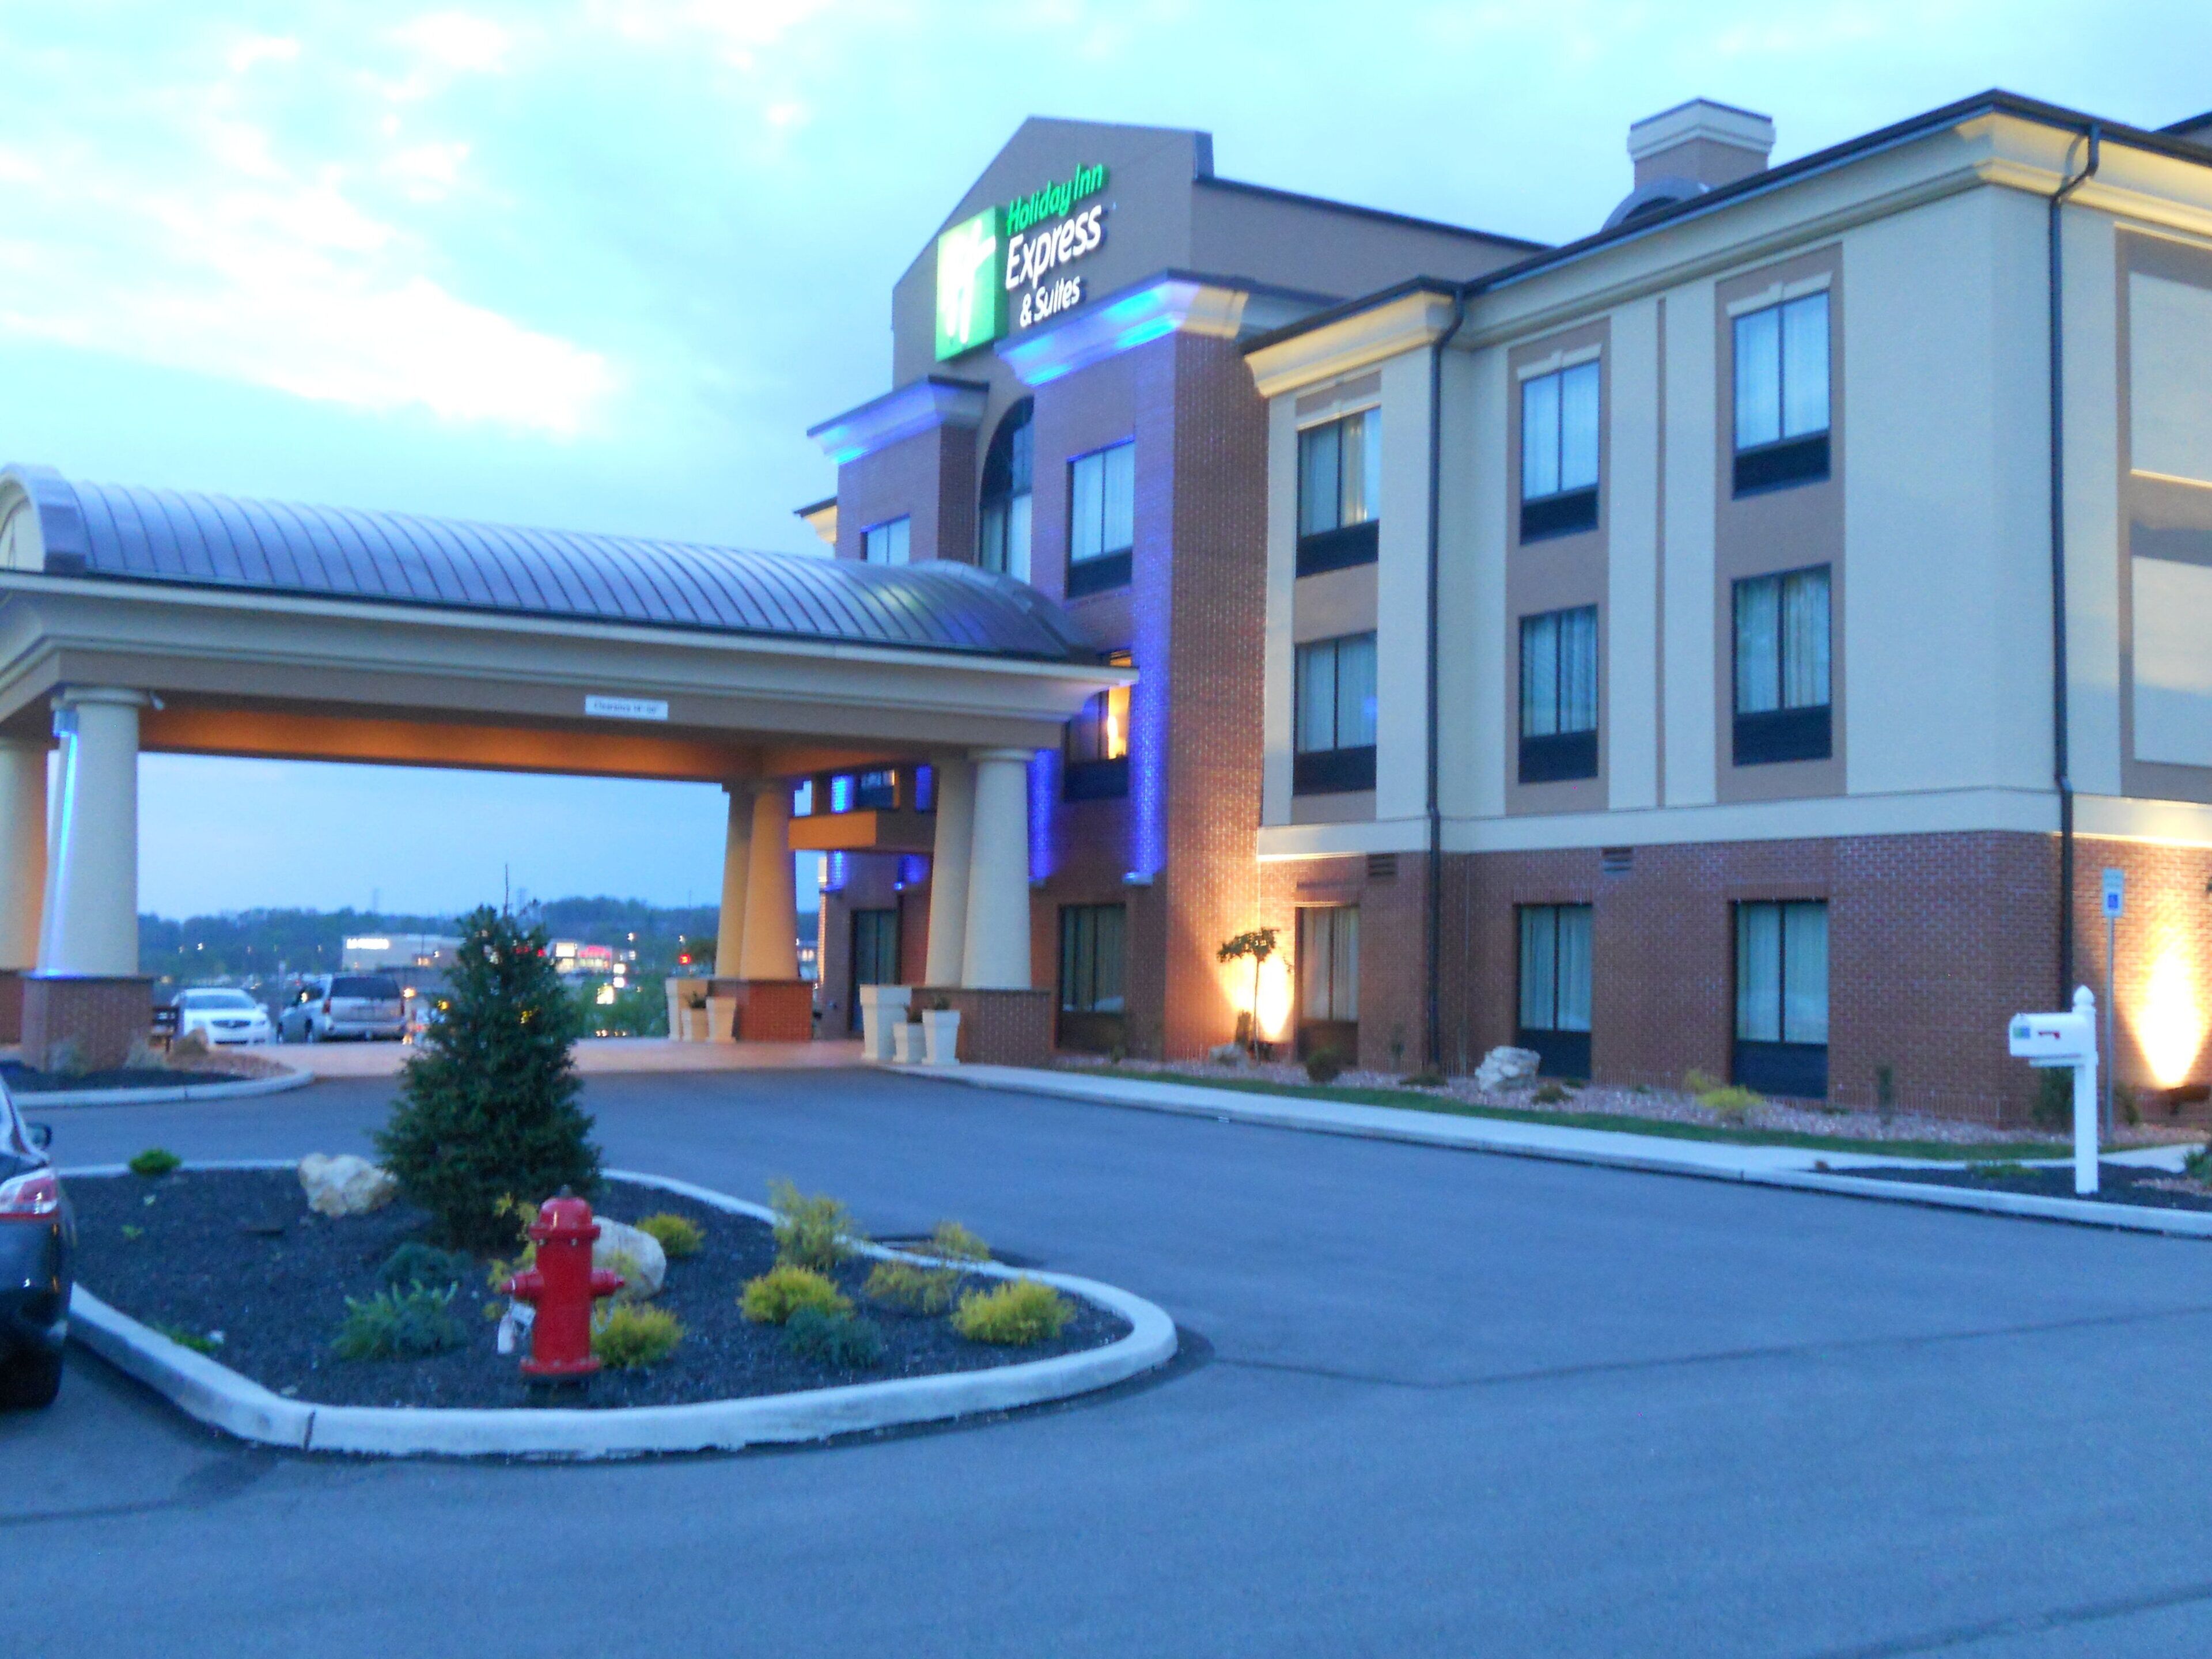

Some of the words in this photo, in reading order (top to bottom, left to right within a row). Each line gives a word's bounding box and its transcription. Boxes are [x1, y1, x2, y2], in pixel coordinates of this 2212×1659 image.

[1005, 179, 1072, 236] Holiday
[1073, 162, 1103, 200] Inn
[1005, 204, 1102, 290] Express
[1019, 293, 1033, 328] &
[1033, 276, 1081, 321] Suites
